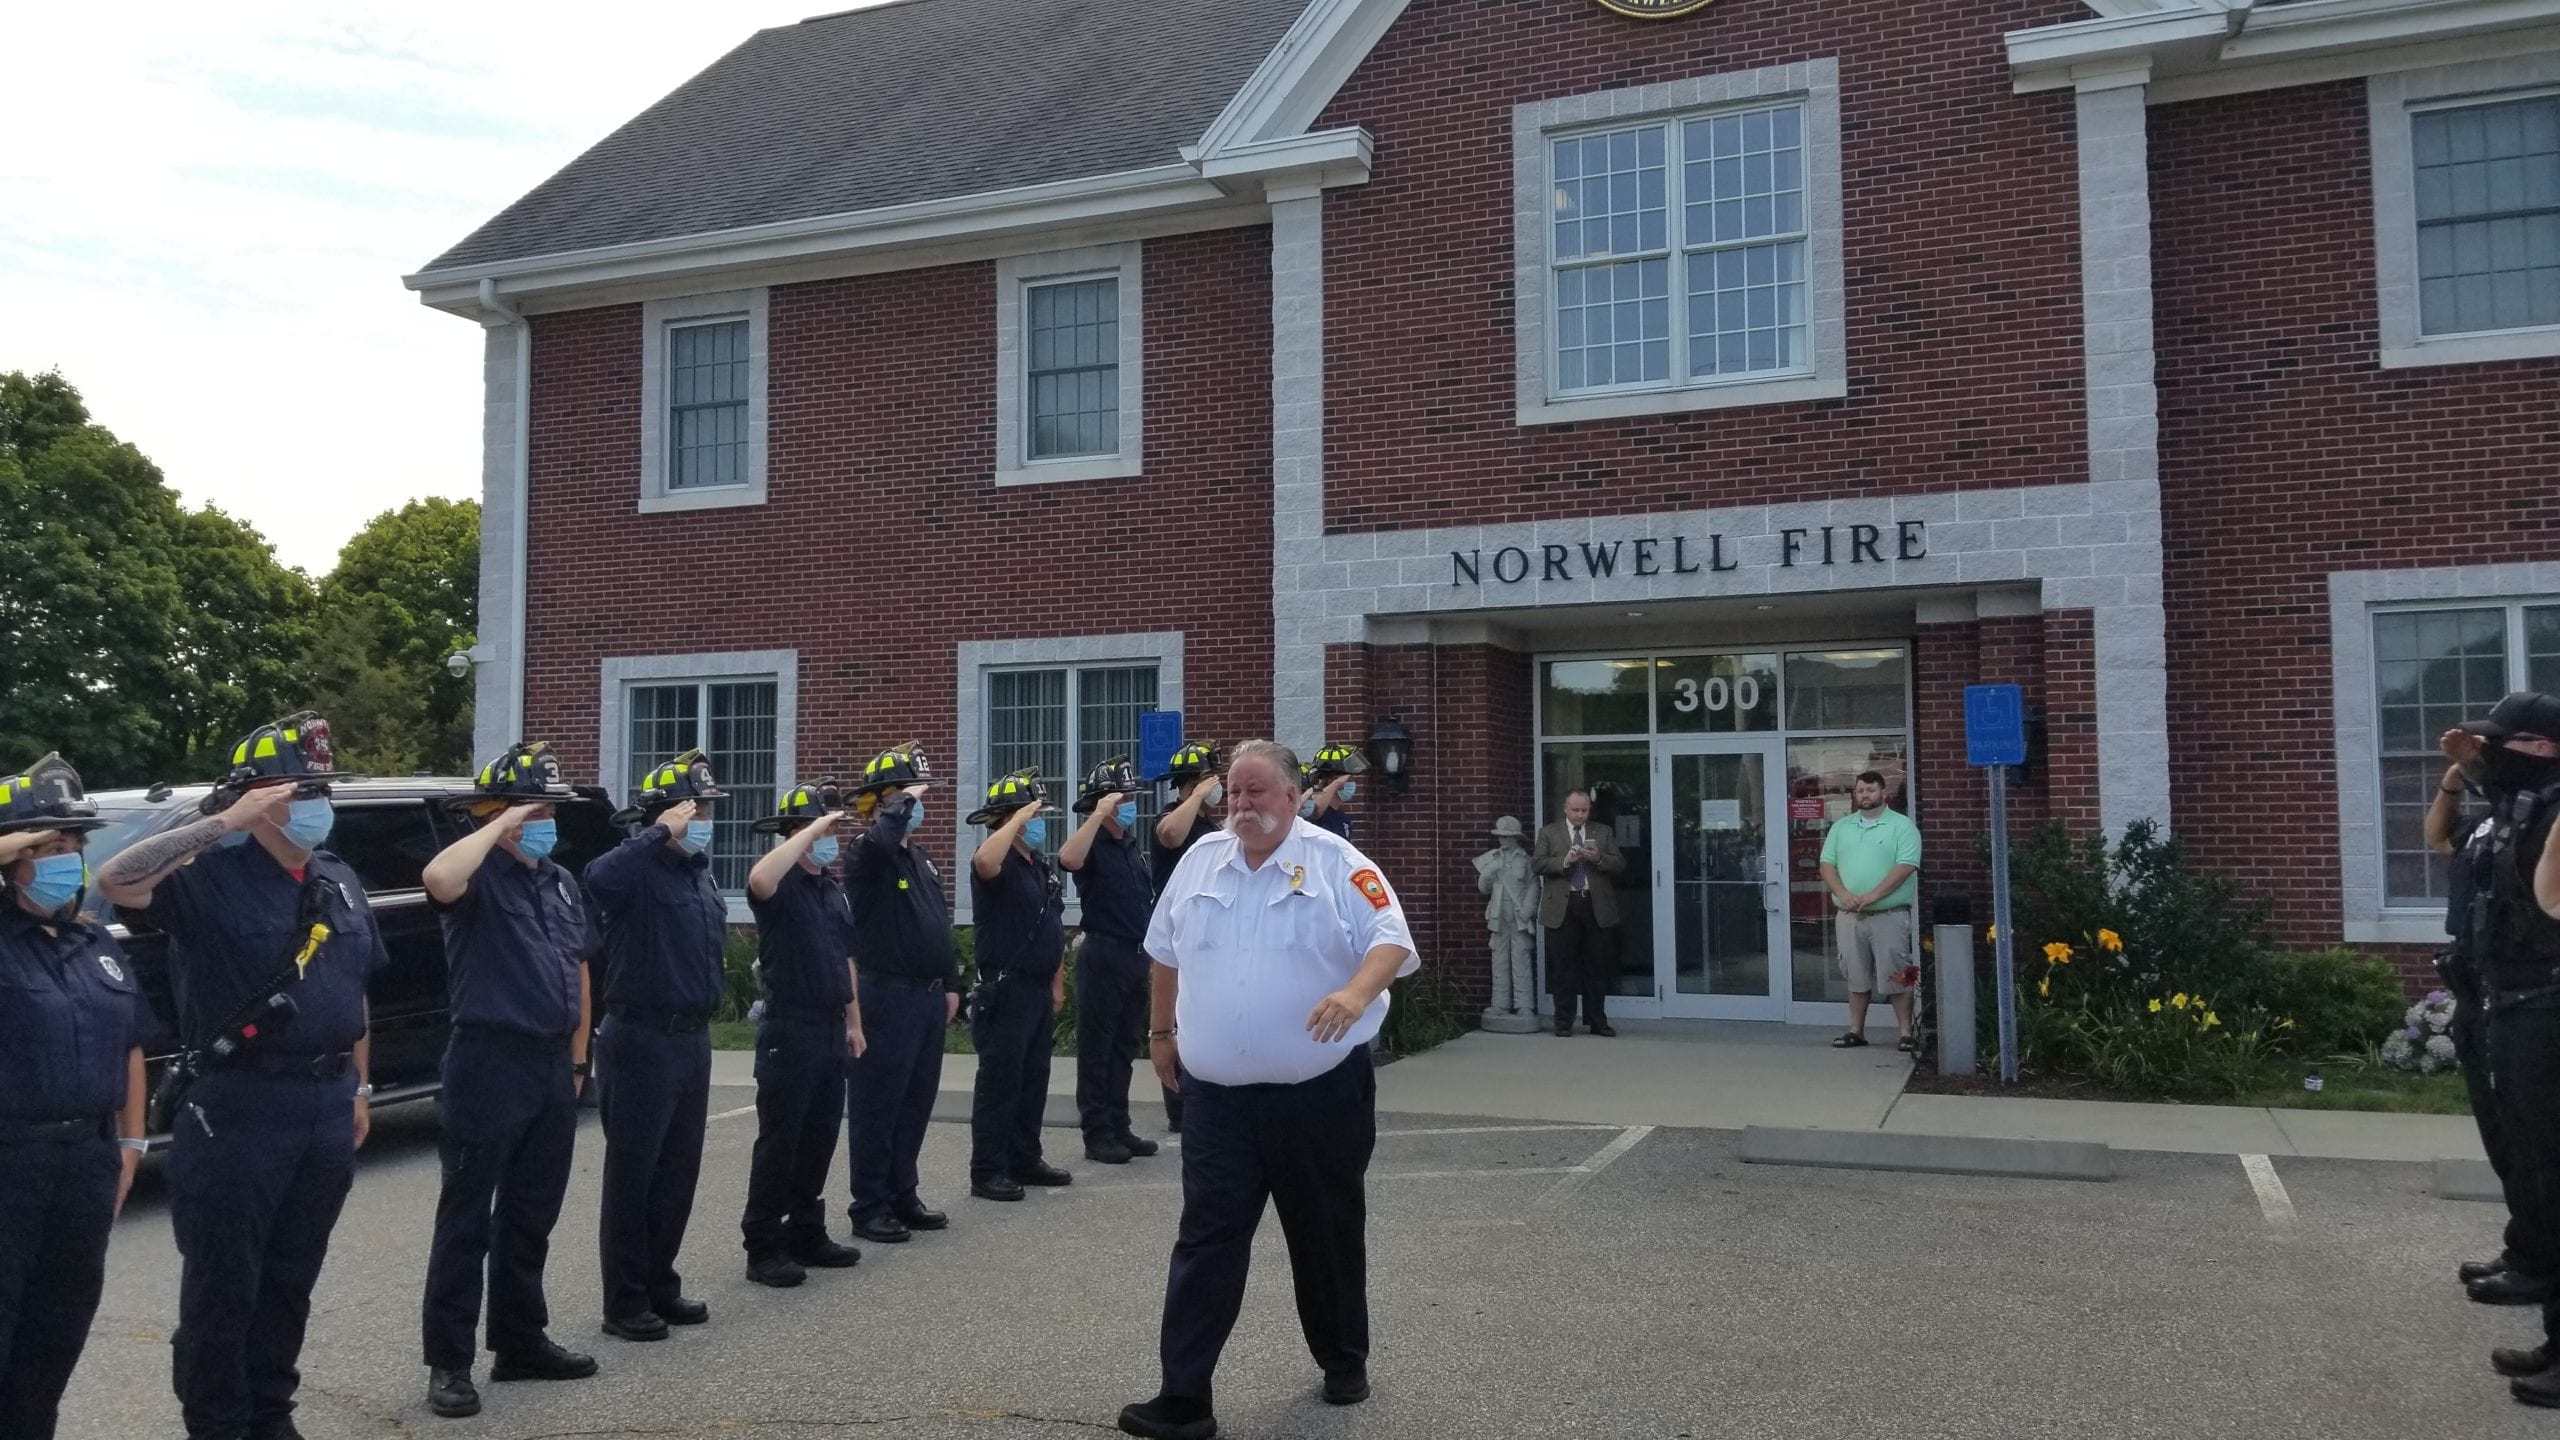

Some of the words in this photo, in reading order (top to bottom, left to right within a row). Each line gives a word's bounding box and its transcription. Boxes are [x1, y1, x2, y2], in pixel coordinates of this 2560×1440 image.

[1450, 533, 1738, 587] NORWELL
[1780, 520, 1928, 568] FIRE
[1674, 676, 1759, 712] 300
[544, 762, 560, 783] 3
[700, 767, 715, 786] 4
[53, 779, 76, 804] 1
